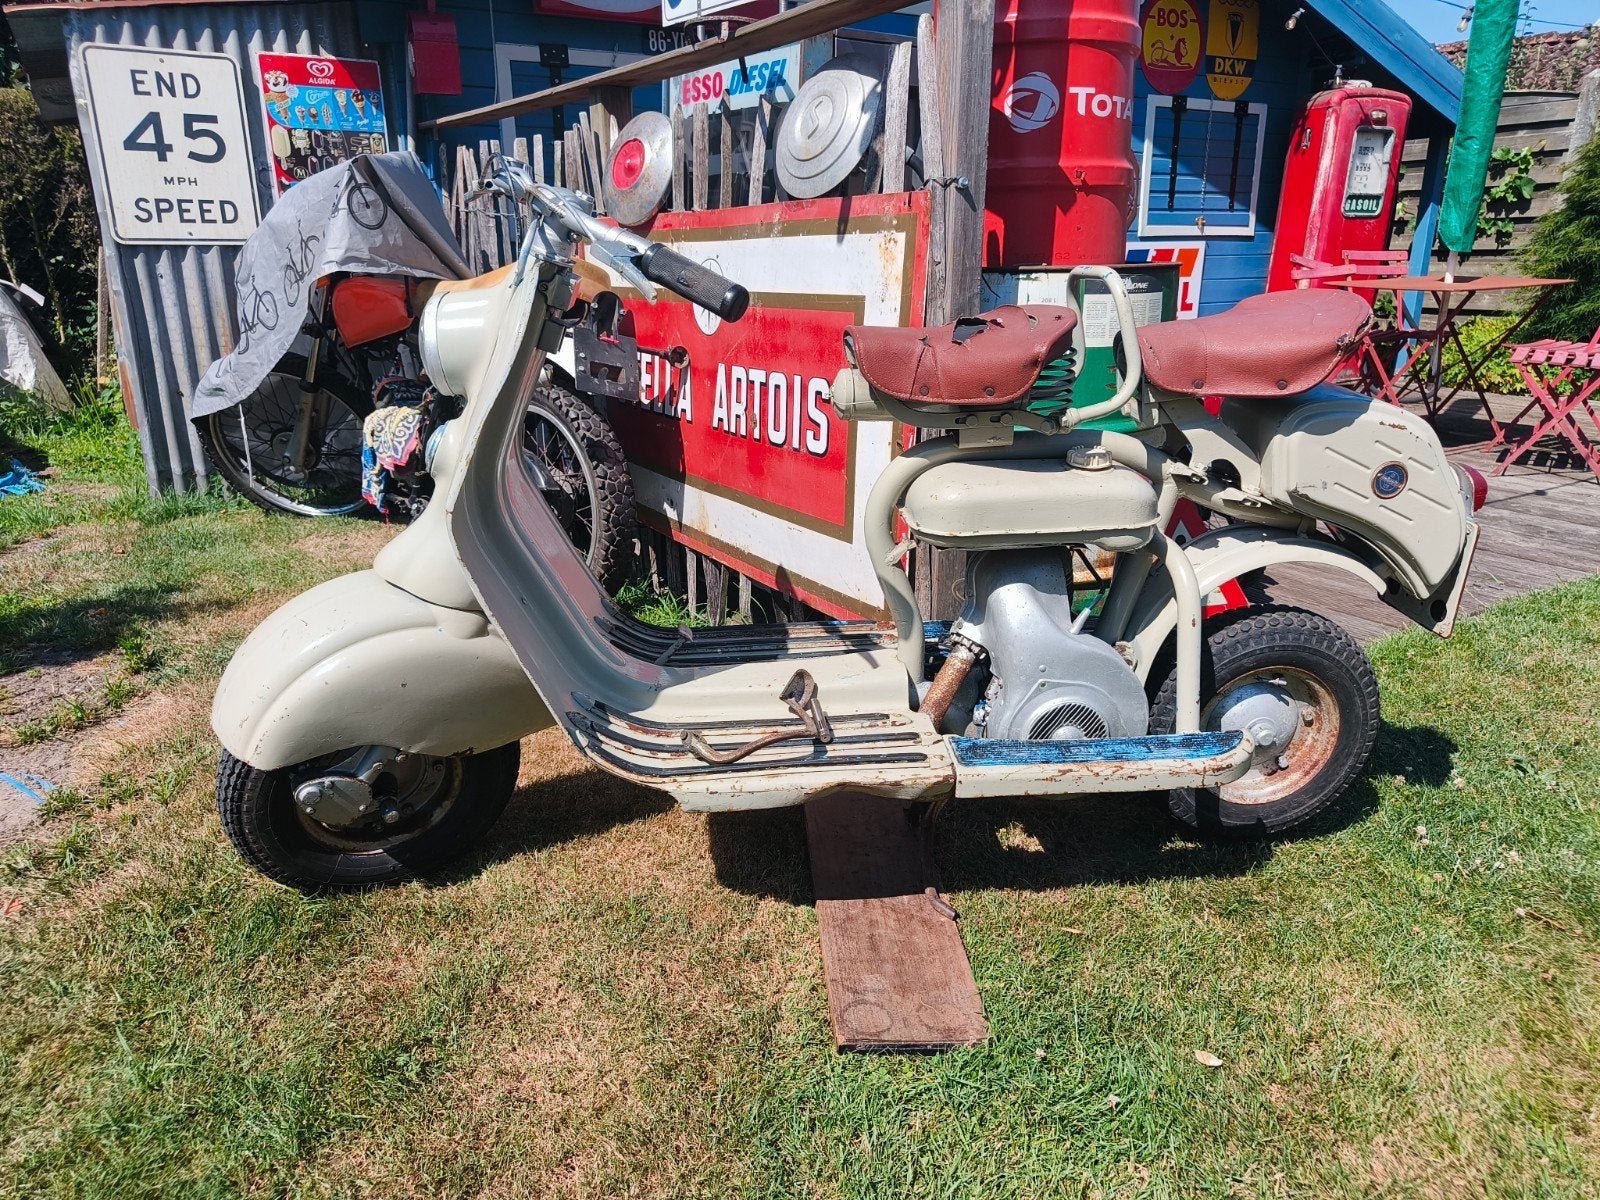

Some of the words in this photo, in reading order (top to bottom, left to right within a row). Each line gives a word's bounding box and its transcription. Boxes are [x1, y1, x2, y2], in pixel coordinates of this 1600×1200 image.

[1157, 8, 1188, 28] BOS
[1215, 57, 1247, 75] DKW
[130, 69, 202, 99] END
[308, 77, 336, 86] ALGIDA
[682, 71, 724, 105] ESSO
[729, 59, 787, 96] DIESEL
[1069, 87, 1133, 121] TOTA
[123, 111, 227, 163] 45
[163, 176, 198, 186] MPH
[134, 197, 239, 224] SPEED
[1345, 199, 1378, 211] GASOIL
[712, 361, 831, 457] ARTOIS
